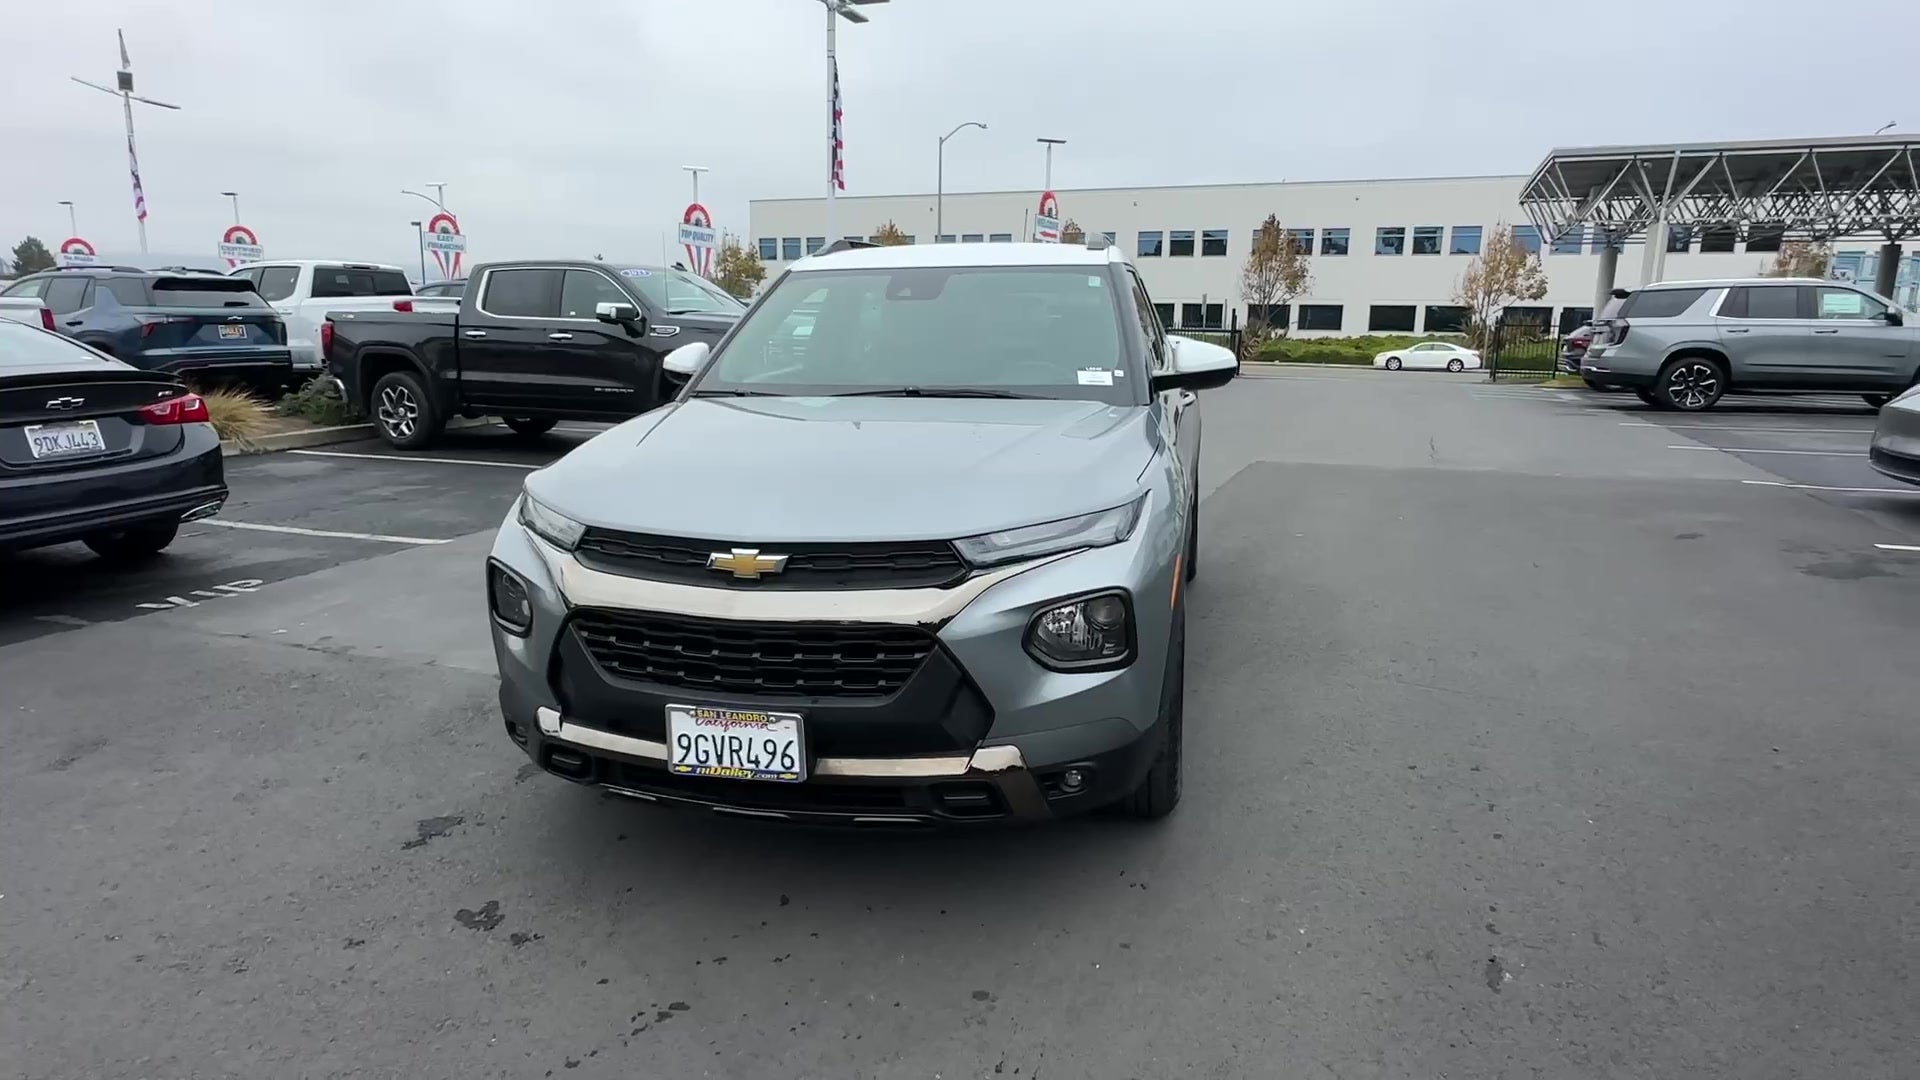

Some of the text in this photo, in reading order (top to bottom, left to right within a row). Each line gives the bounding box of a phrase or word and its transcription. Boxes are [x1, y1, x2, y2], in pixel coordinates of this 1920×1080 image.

[437, 234, 455, 242] EASY
[681, 229, 714, 243] TOP QUALITY
[696, 709, 768, 723] SAN LEANDRO
[677, 733, 796, 771] 9GVR496
